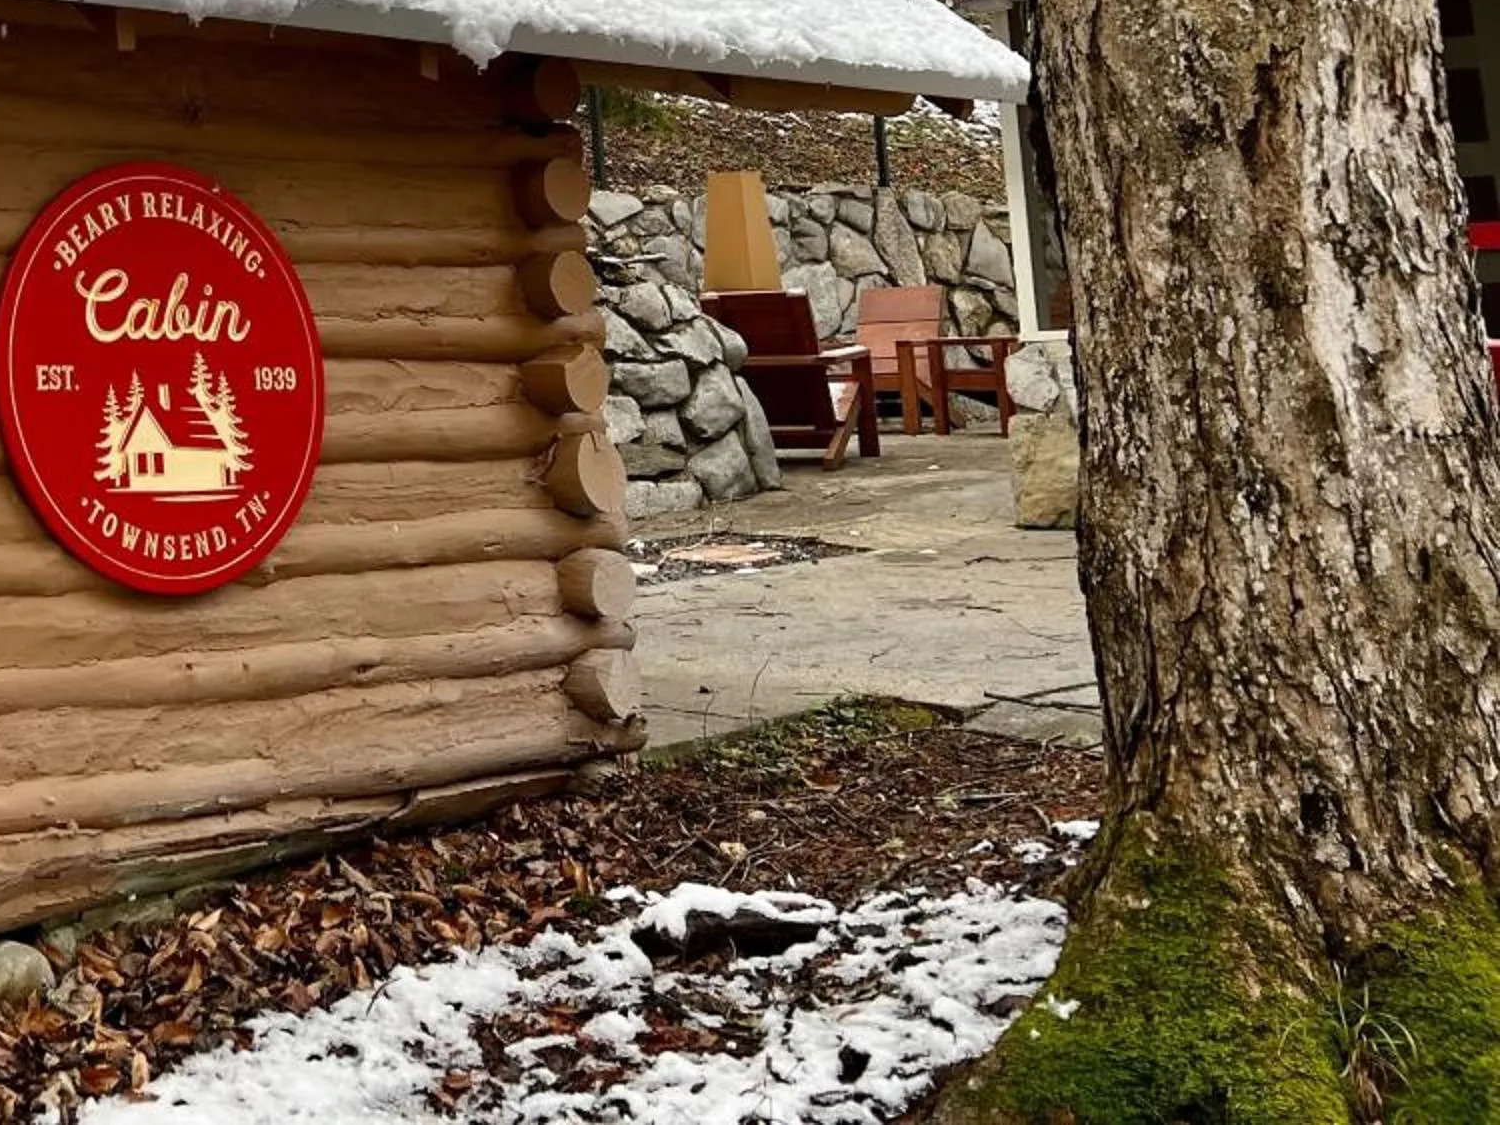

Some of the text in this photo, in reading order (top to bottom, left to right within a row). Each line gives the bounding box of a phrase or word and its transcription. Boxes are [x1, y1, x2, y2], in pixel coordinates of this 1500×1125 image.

[57, 191, 264, 274] BEARY RELAXING
[75, 268, 250, 343] Cabin
[36, 365, 79, 392] EST.
[253, 366, 297, 392] 1939
[235, 494, 268, 533] TN
